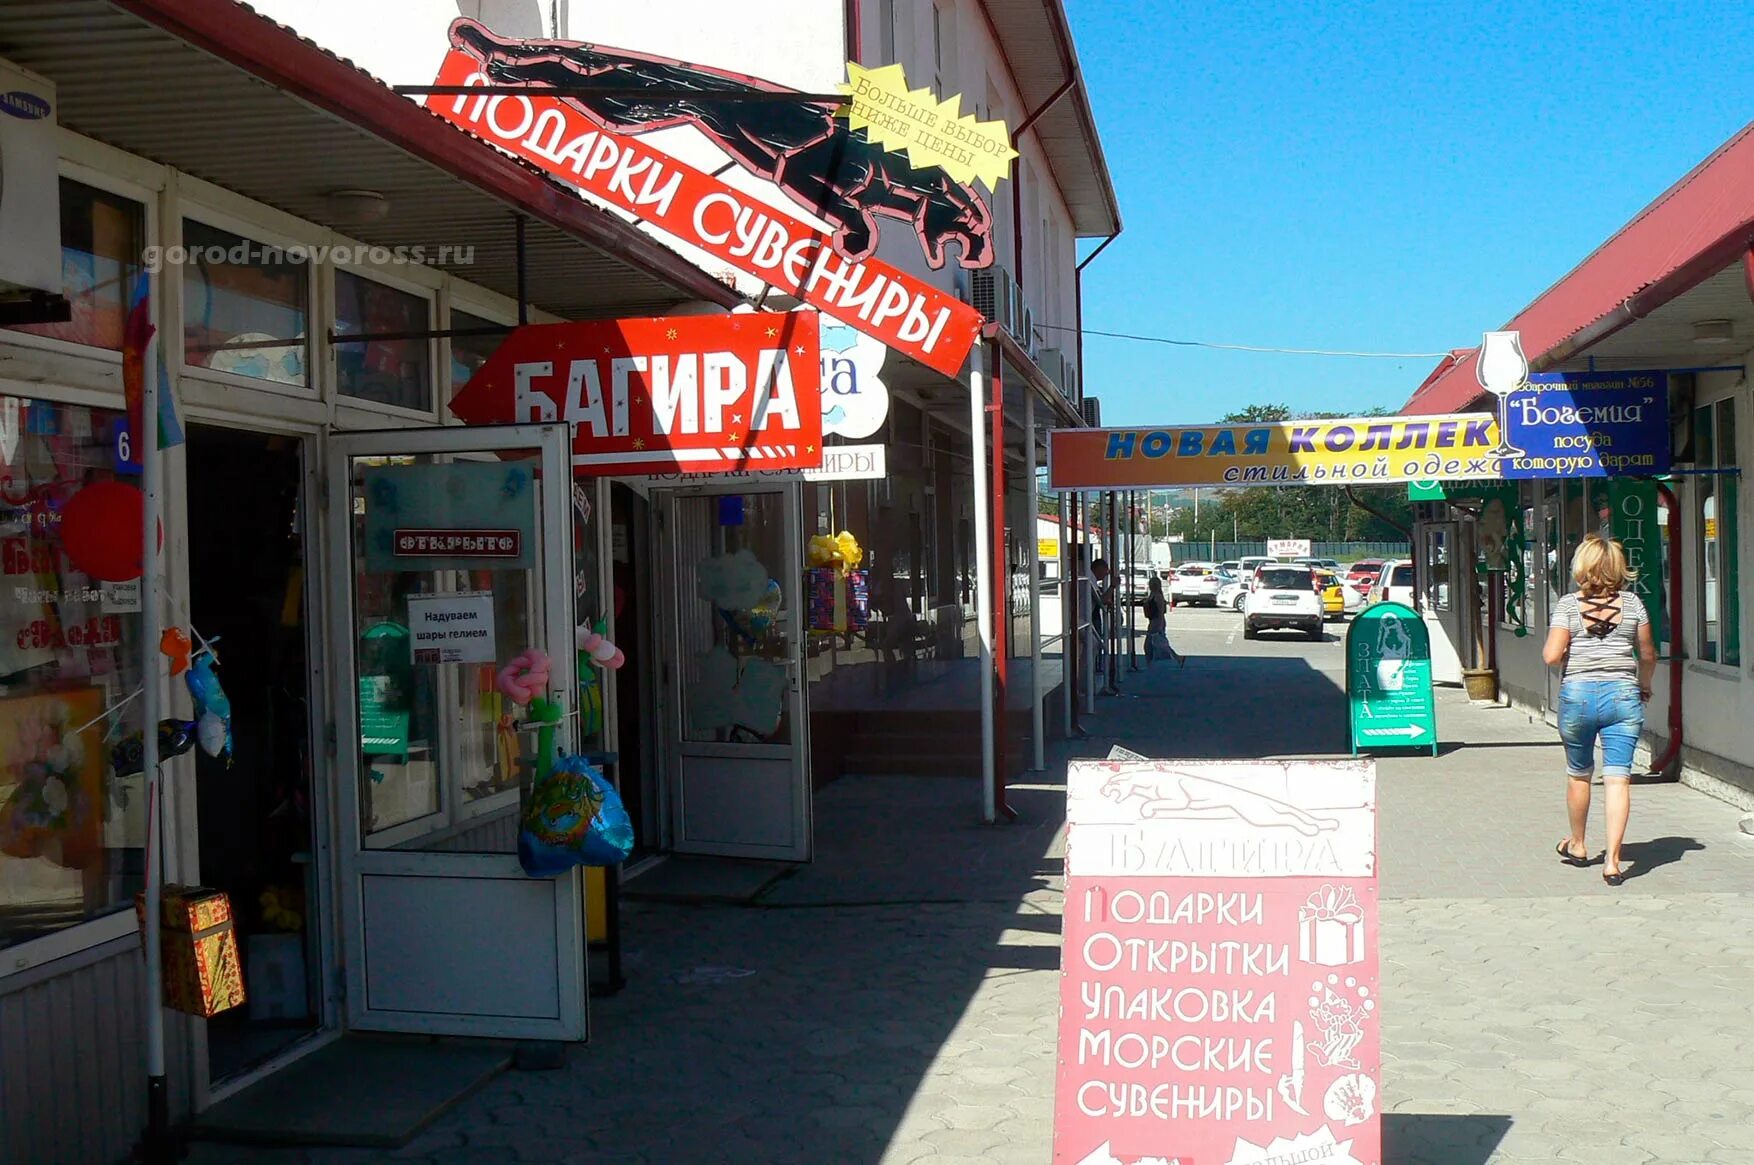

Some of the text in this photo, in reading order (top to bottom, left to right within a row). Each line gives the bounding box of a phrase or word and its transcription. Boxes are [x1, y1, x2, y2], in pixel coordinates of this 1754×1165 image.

[849, 100, 977, 167] НИЖЕ ЦЕНЫ
[853, 76, 1008, 158] БОЛЬШЕ ВЫБОР
[451, 72, 952, 354] ПОДАРКИ СУВЕНИРЫ
[513, 347, 802, 440] БАГИРА
[117, 431, 131, 462] 6
[1104, 418, 1494, 461] НОВАЯ КОЛЛЕК
[1553, 431, 1612, 453] посуда
[1222, 453, 1390, 483] стильной
[1512, 452, 1654, 474] которую дарят
[399, 535, 514, 551] ОТКРЫТО
[416, 629, 488, 642] шары гелием
[424, 610, 478, 623] Надуваем
[1355, 642, 1374, 719] ЗЛАТА
[1110, 831, 1344, 873] БАГИРА
[1084, 886, 1264, 926] ПОДАРКИ
[1082, 931, 1290, 977] ОТКРЫТКИ
[1080, 980, 1276, 1024] УПАКОВКА
[1077, 1027, 1274, 1075] МОРСКИЕ
[1076, 1080, 1274, 1122] СУВЕНИРЫ
